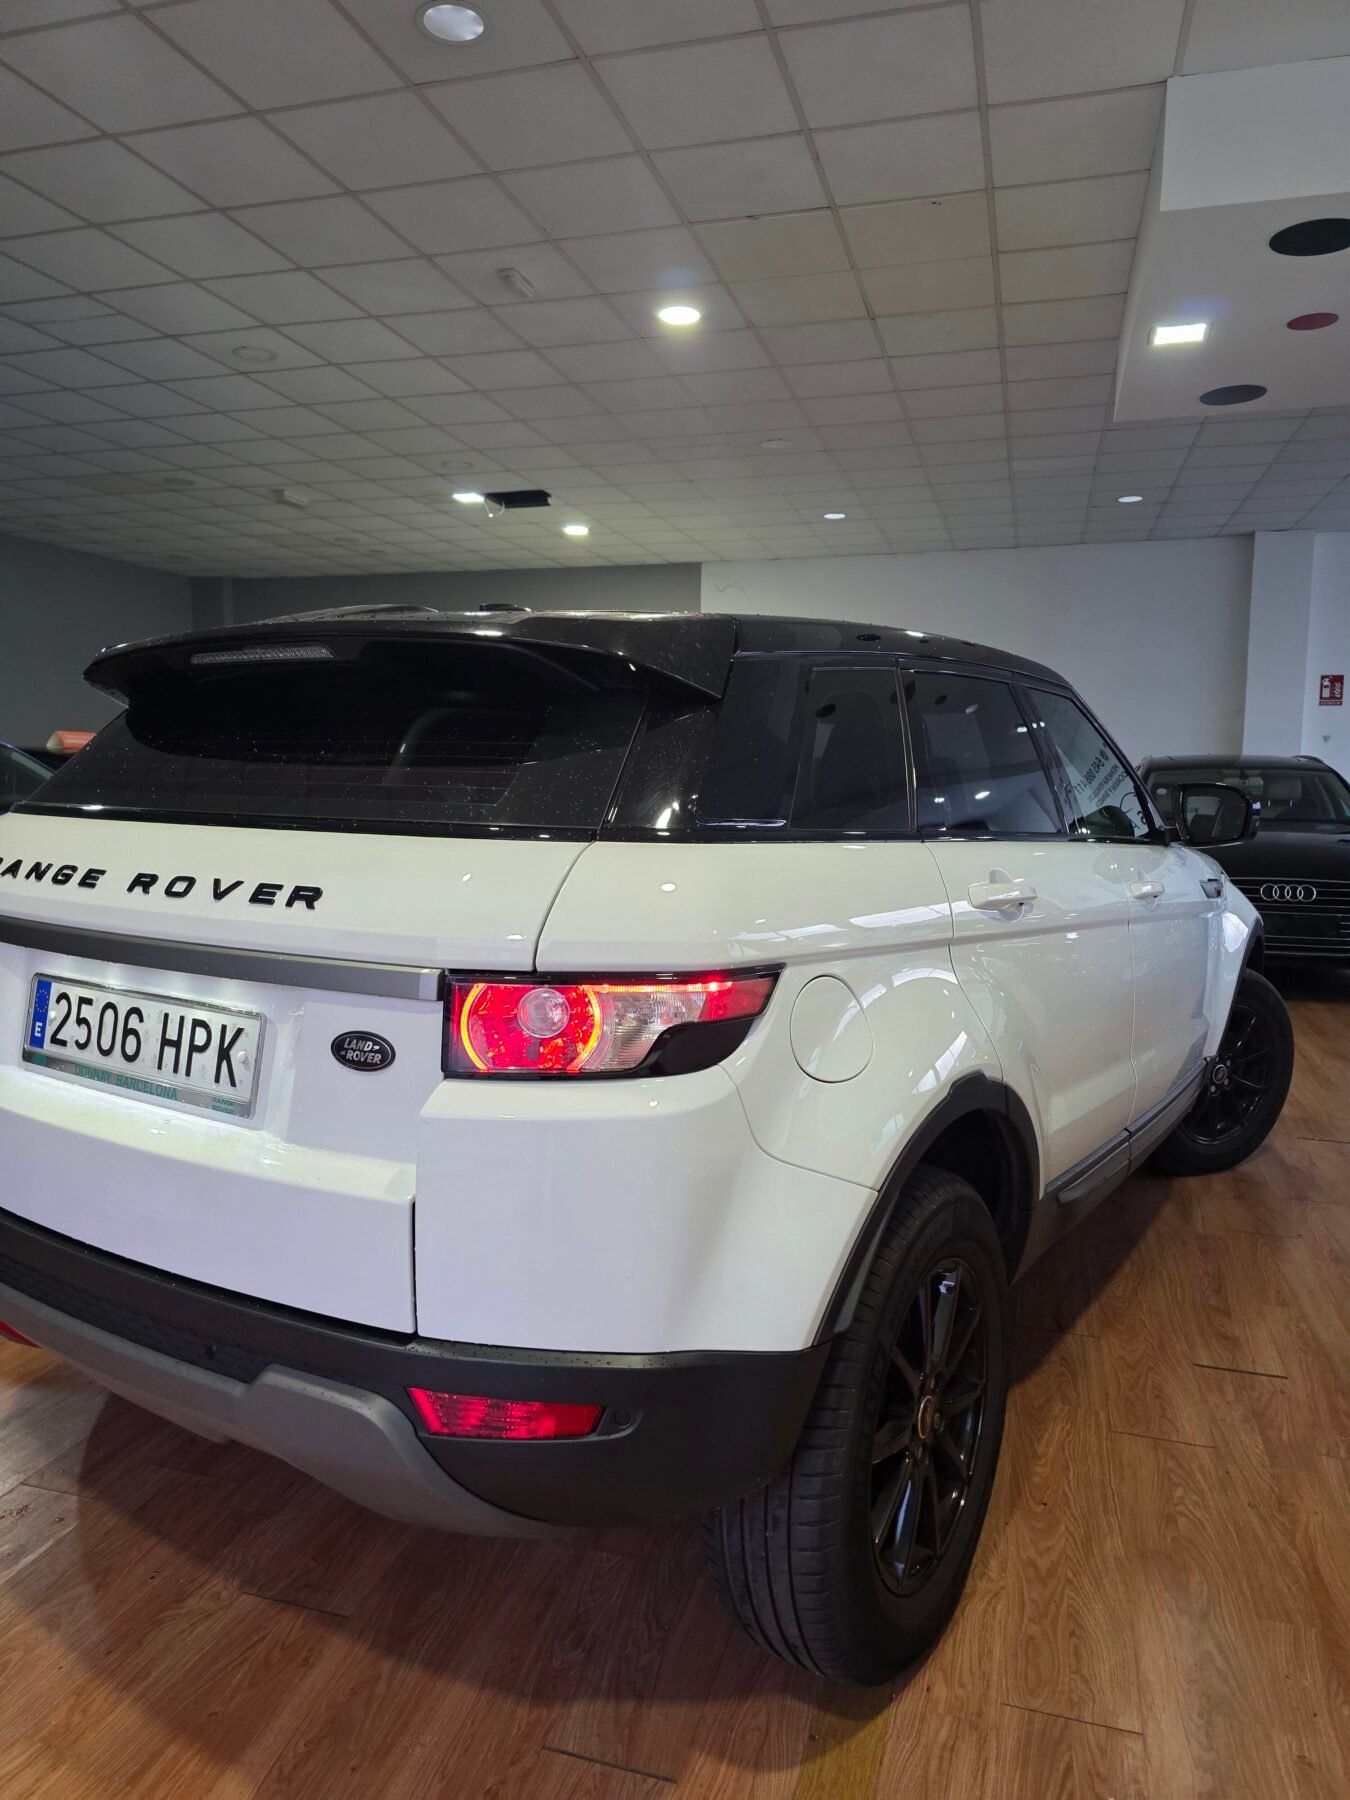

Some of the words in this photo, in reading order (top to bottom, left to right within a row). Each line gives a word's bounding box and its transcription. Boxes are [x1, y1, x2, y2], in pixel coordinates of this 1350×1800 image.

[0, 857, 107, 888] ANGE
[127, 873, 323, 910] ROVER
[34, 1022, 44, 1038] E
[50, 992, 144, 1062] 2506
[157, 1012, 245, 1088] HPK
[343, 1038, 373, 1051] LAND
[345, 1049, 382, 1064] ROVER
[115, 1073, 177, 1101] BARCELONA
